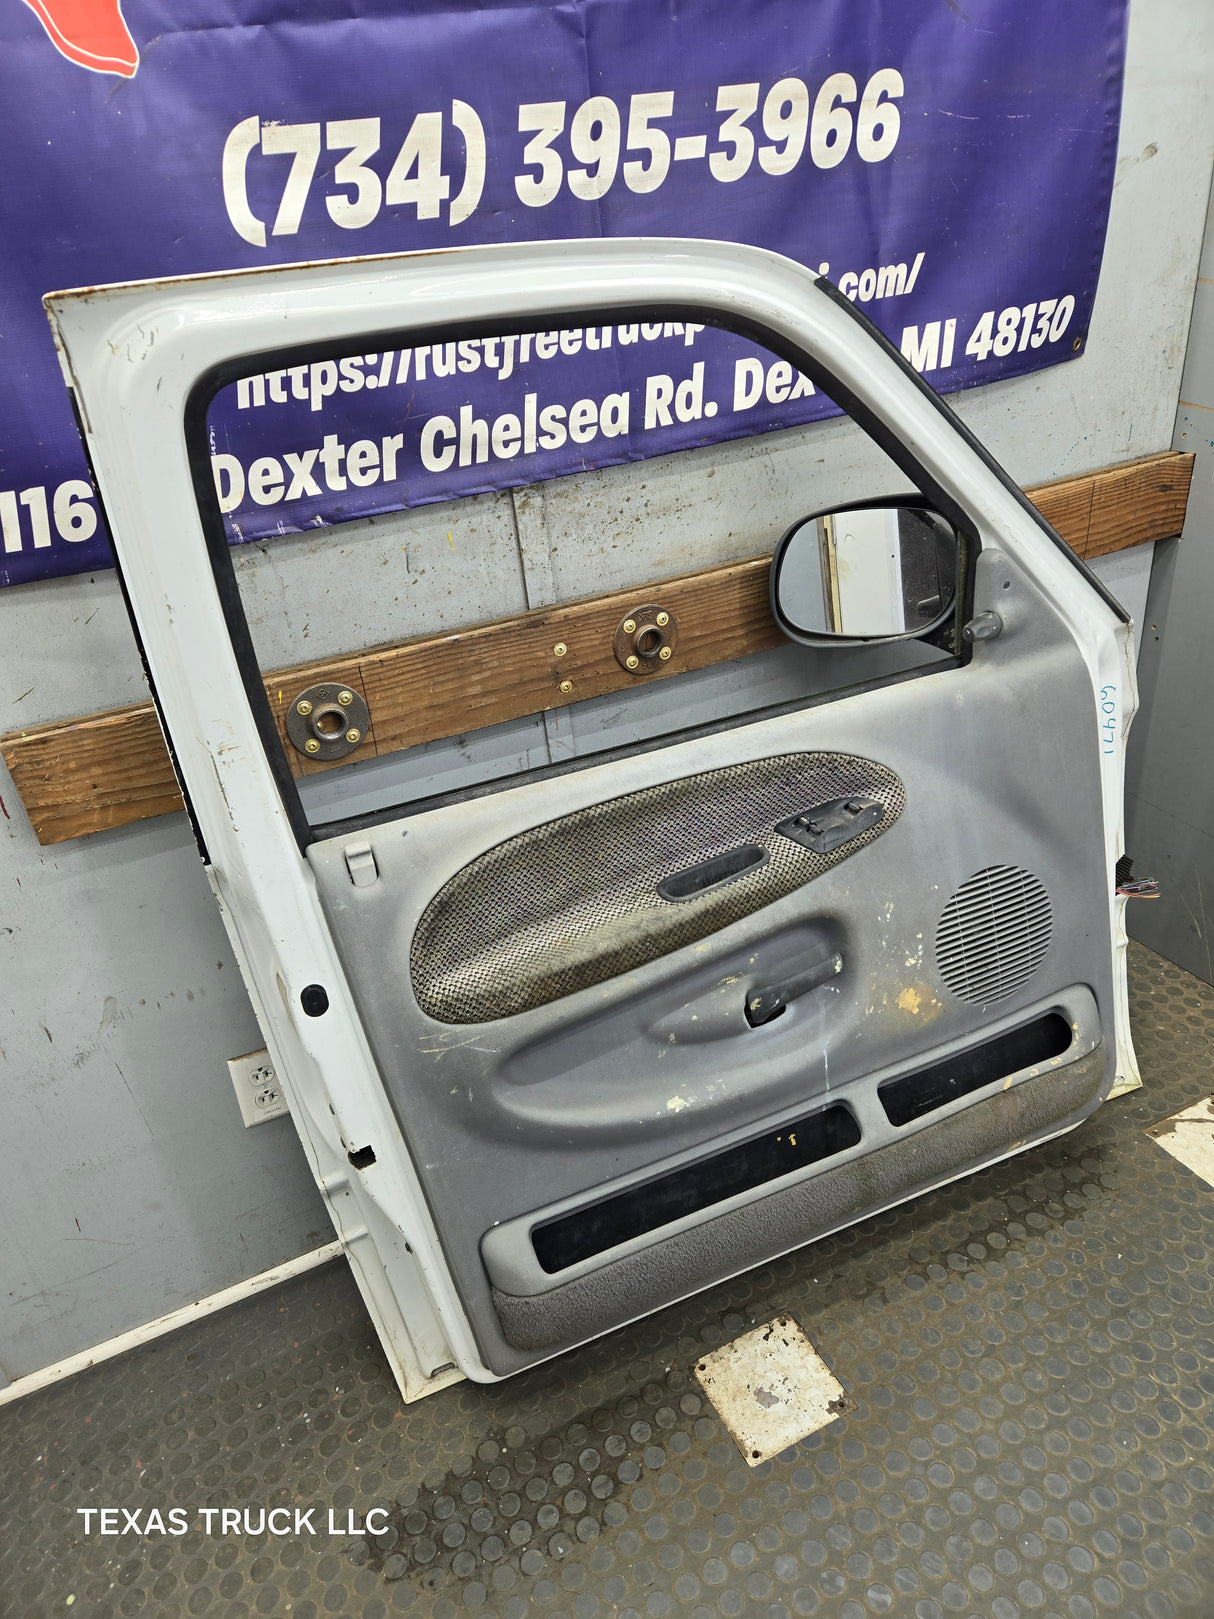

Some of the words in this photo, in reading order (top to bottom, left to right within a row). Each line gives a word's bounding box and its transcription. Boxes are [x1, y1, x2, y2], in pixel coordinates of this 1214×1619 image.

[222, 99, 486, 247] (734)
[514, 68, 904, 208] 395-3966
[210, 433, 404, 513] Dexter
[420, 393, 630, 472] Chelsea
[644, 361, 719, 431] Rd.
[900, 318, 957, 373] MI
[965, 294, 1076, 362] 48130
